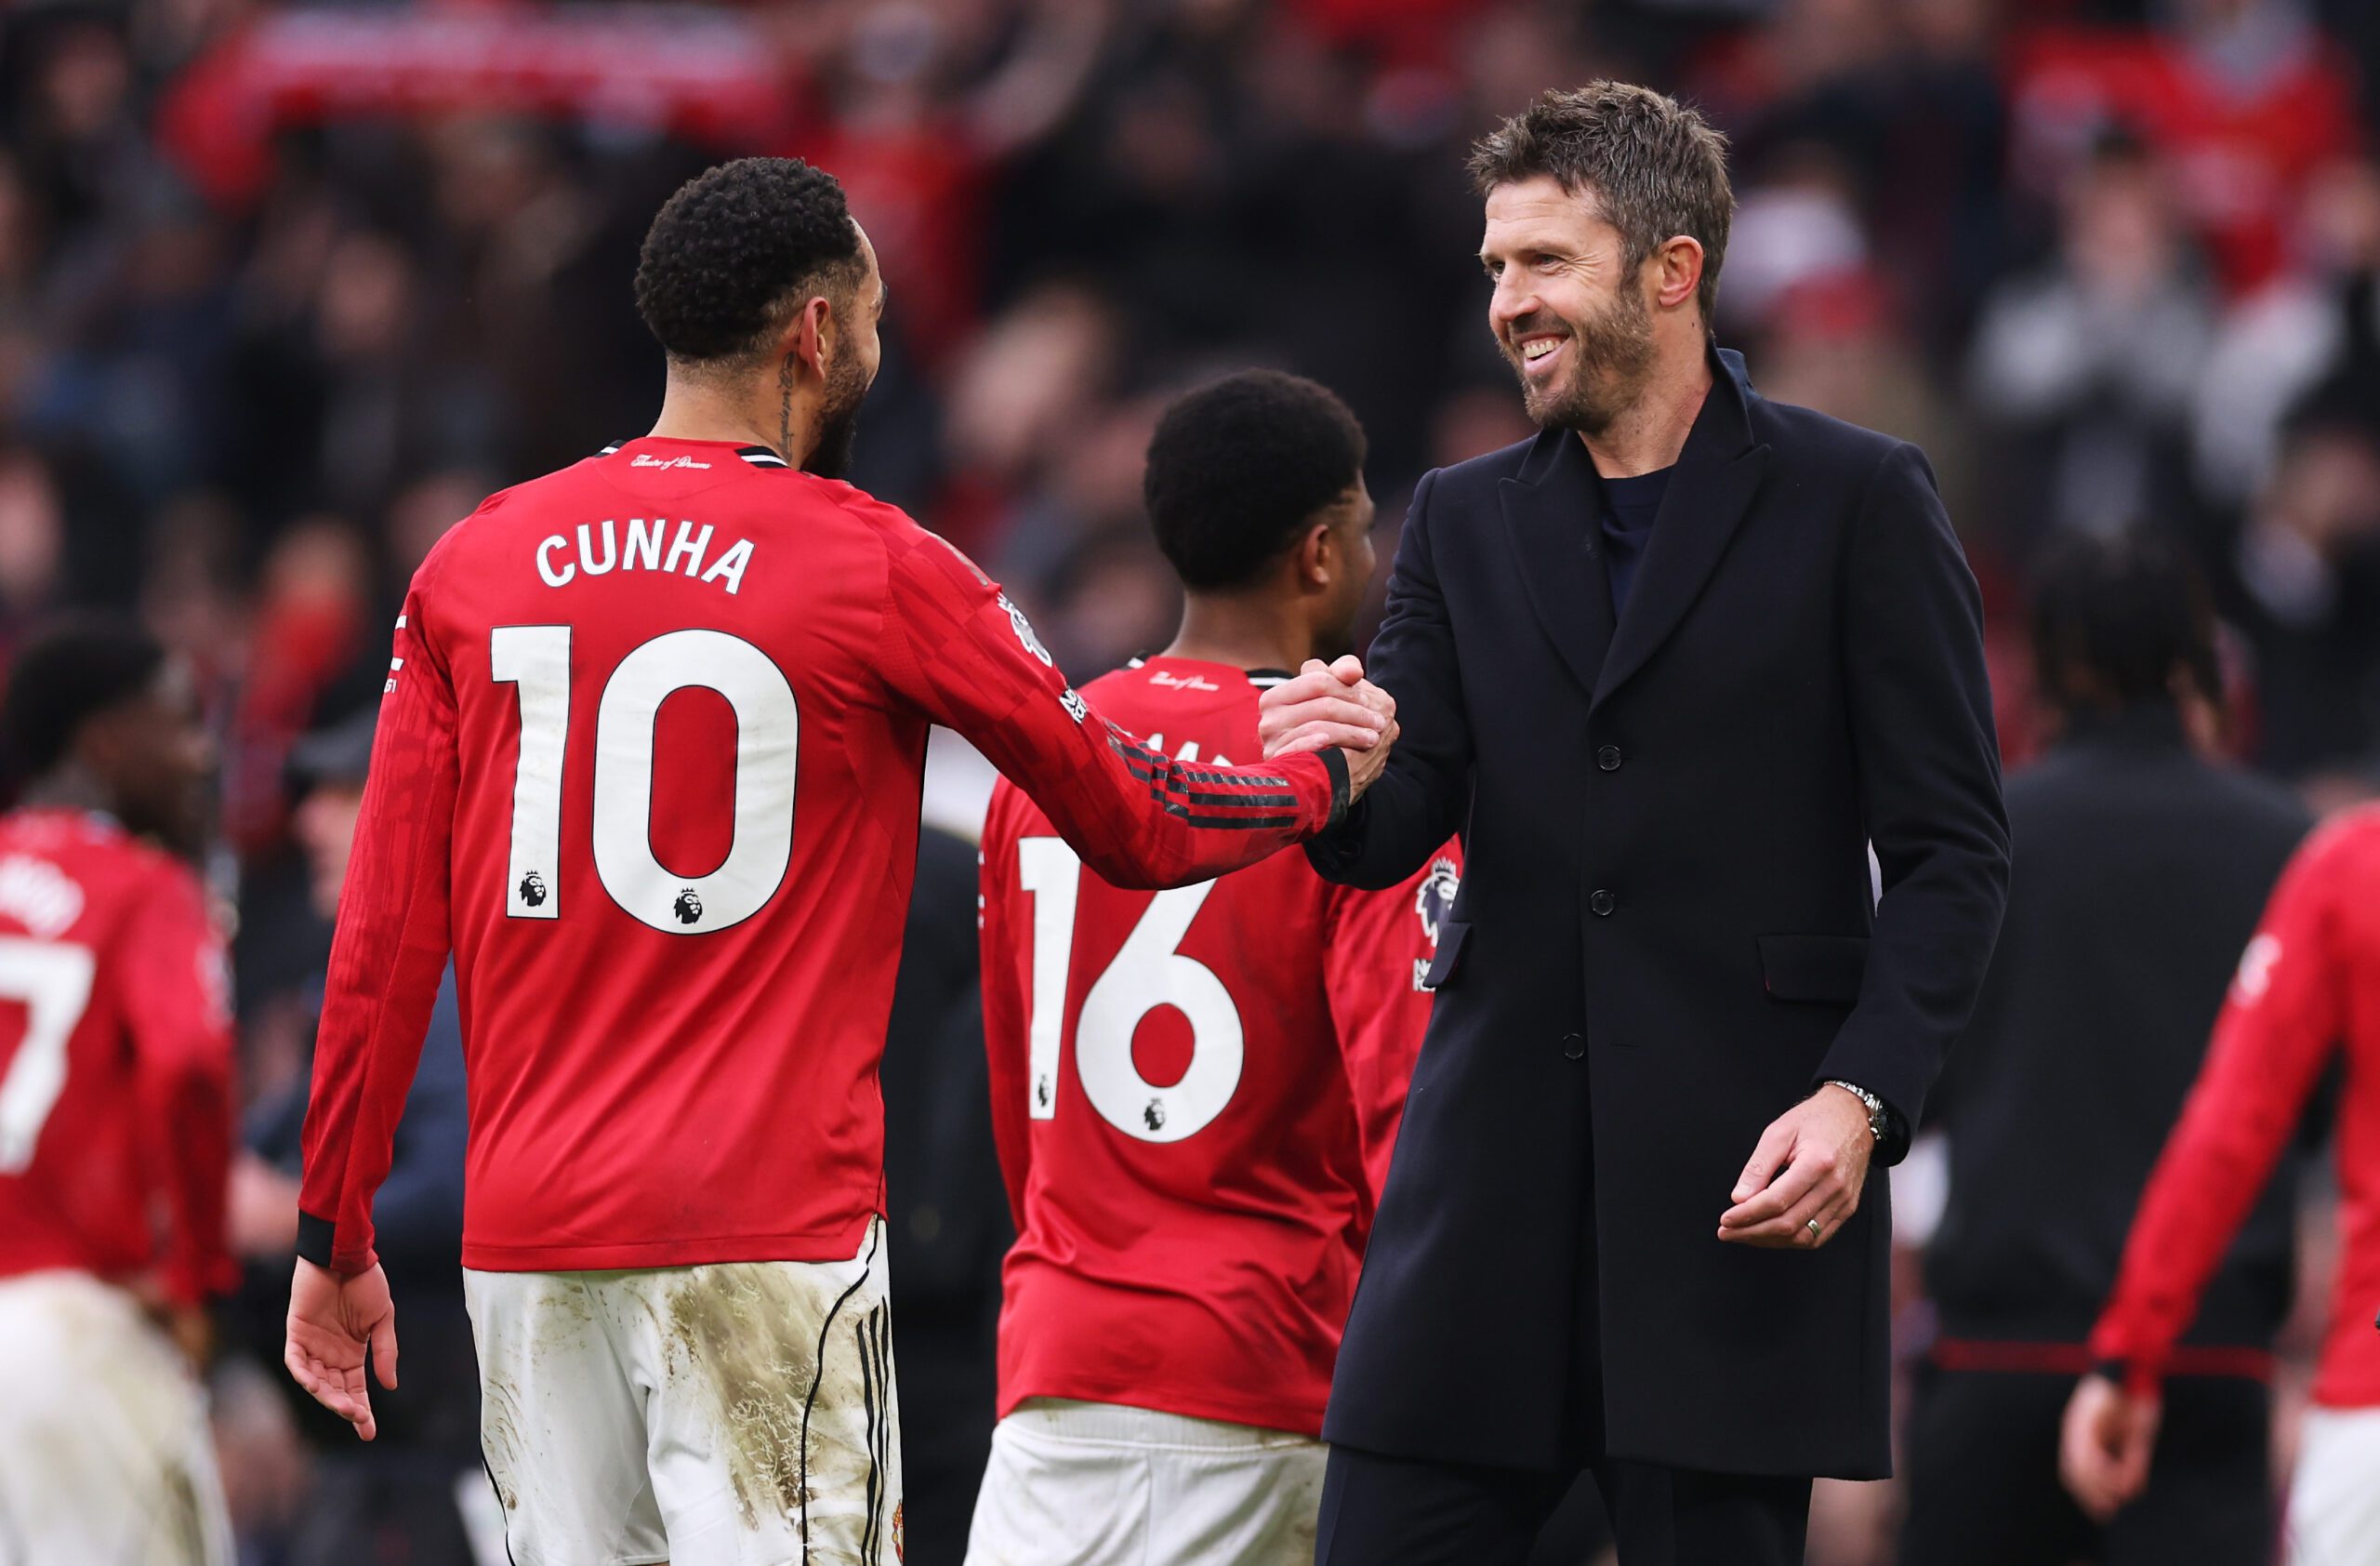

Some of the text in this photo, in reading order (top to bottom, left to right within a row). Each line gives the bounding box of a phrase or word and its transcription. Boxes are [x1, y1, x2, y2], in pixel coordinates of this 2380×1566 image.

[536, 518, 755, 595] CUNHA
[490, 624, 799, 936] 10
[0, 934, 95, 1174] 7
[1018, 836, 1245, 1144] 16
